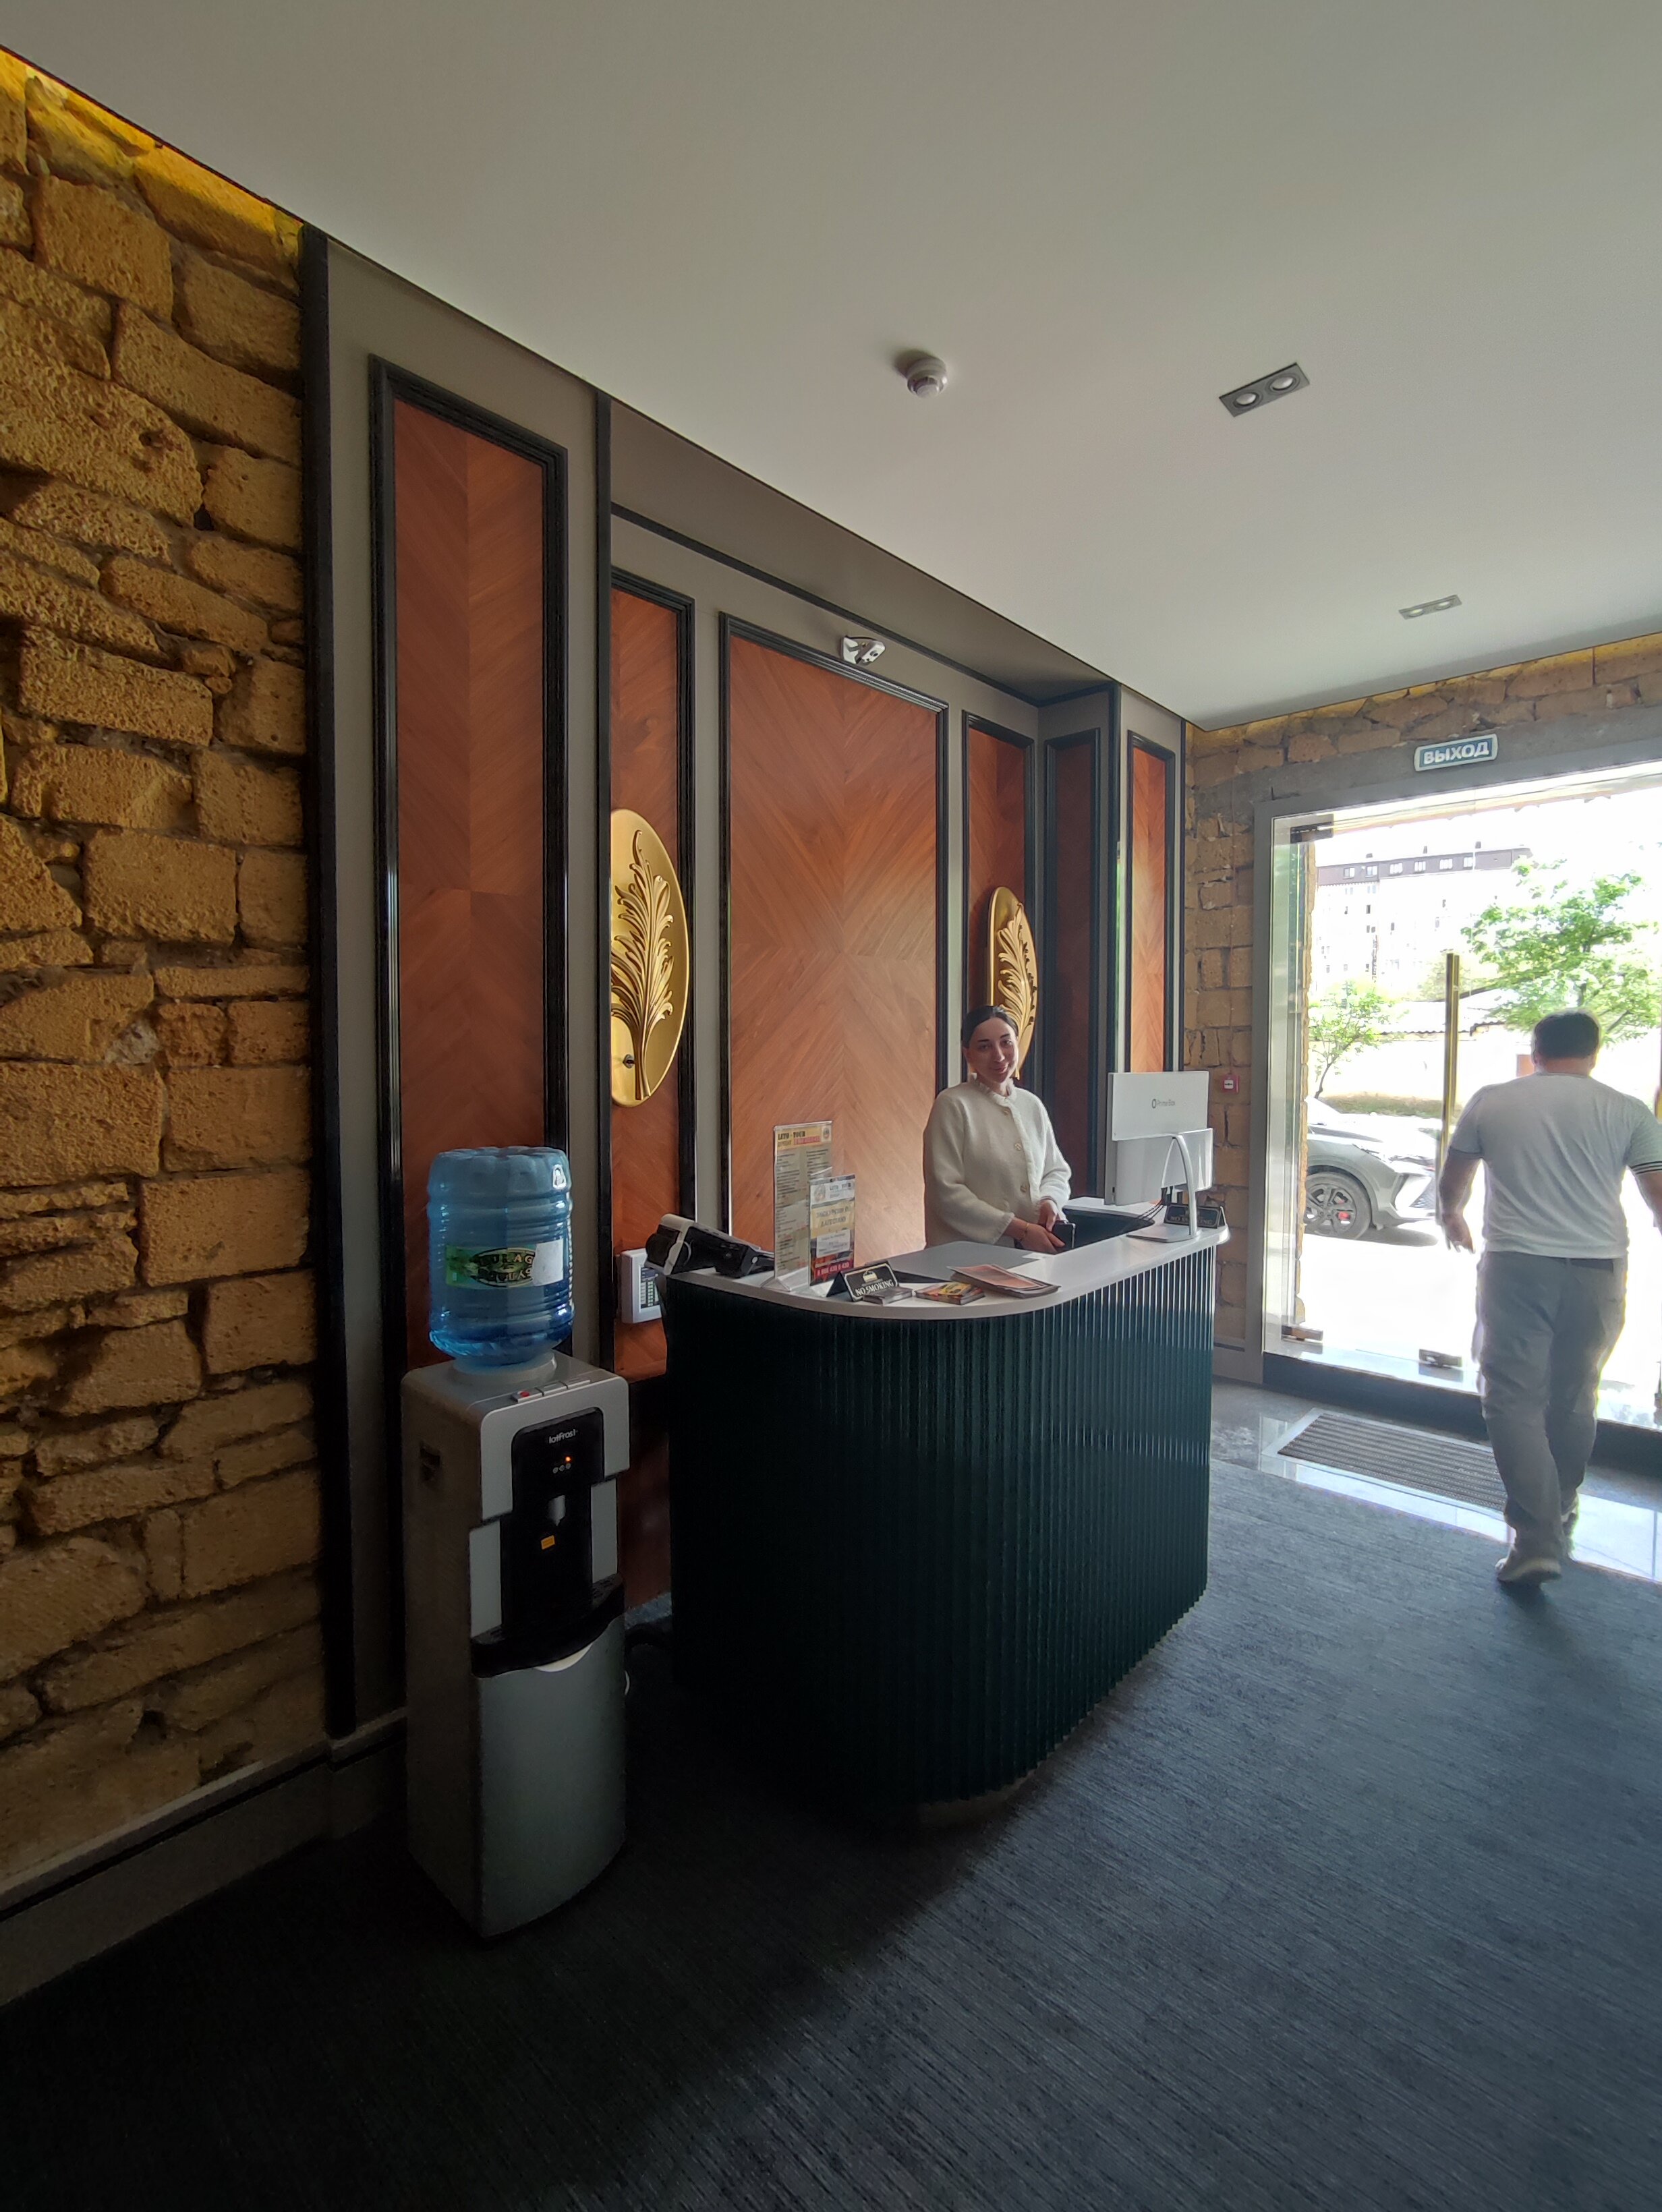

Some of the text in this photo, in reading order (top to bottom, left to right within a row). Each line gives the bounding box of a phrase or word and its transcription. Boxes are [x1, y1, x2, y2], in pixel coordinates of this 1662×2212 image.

[1424, 742, 1489, 764] ВЫХОД
[855, 1286, 866, 1296] NO
[865, 1279, 894, 1295] SMOKING
